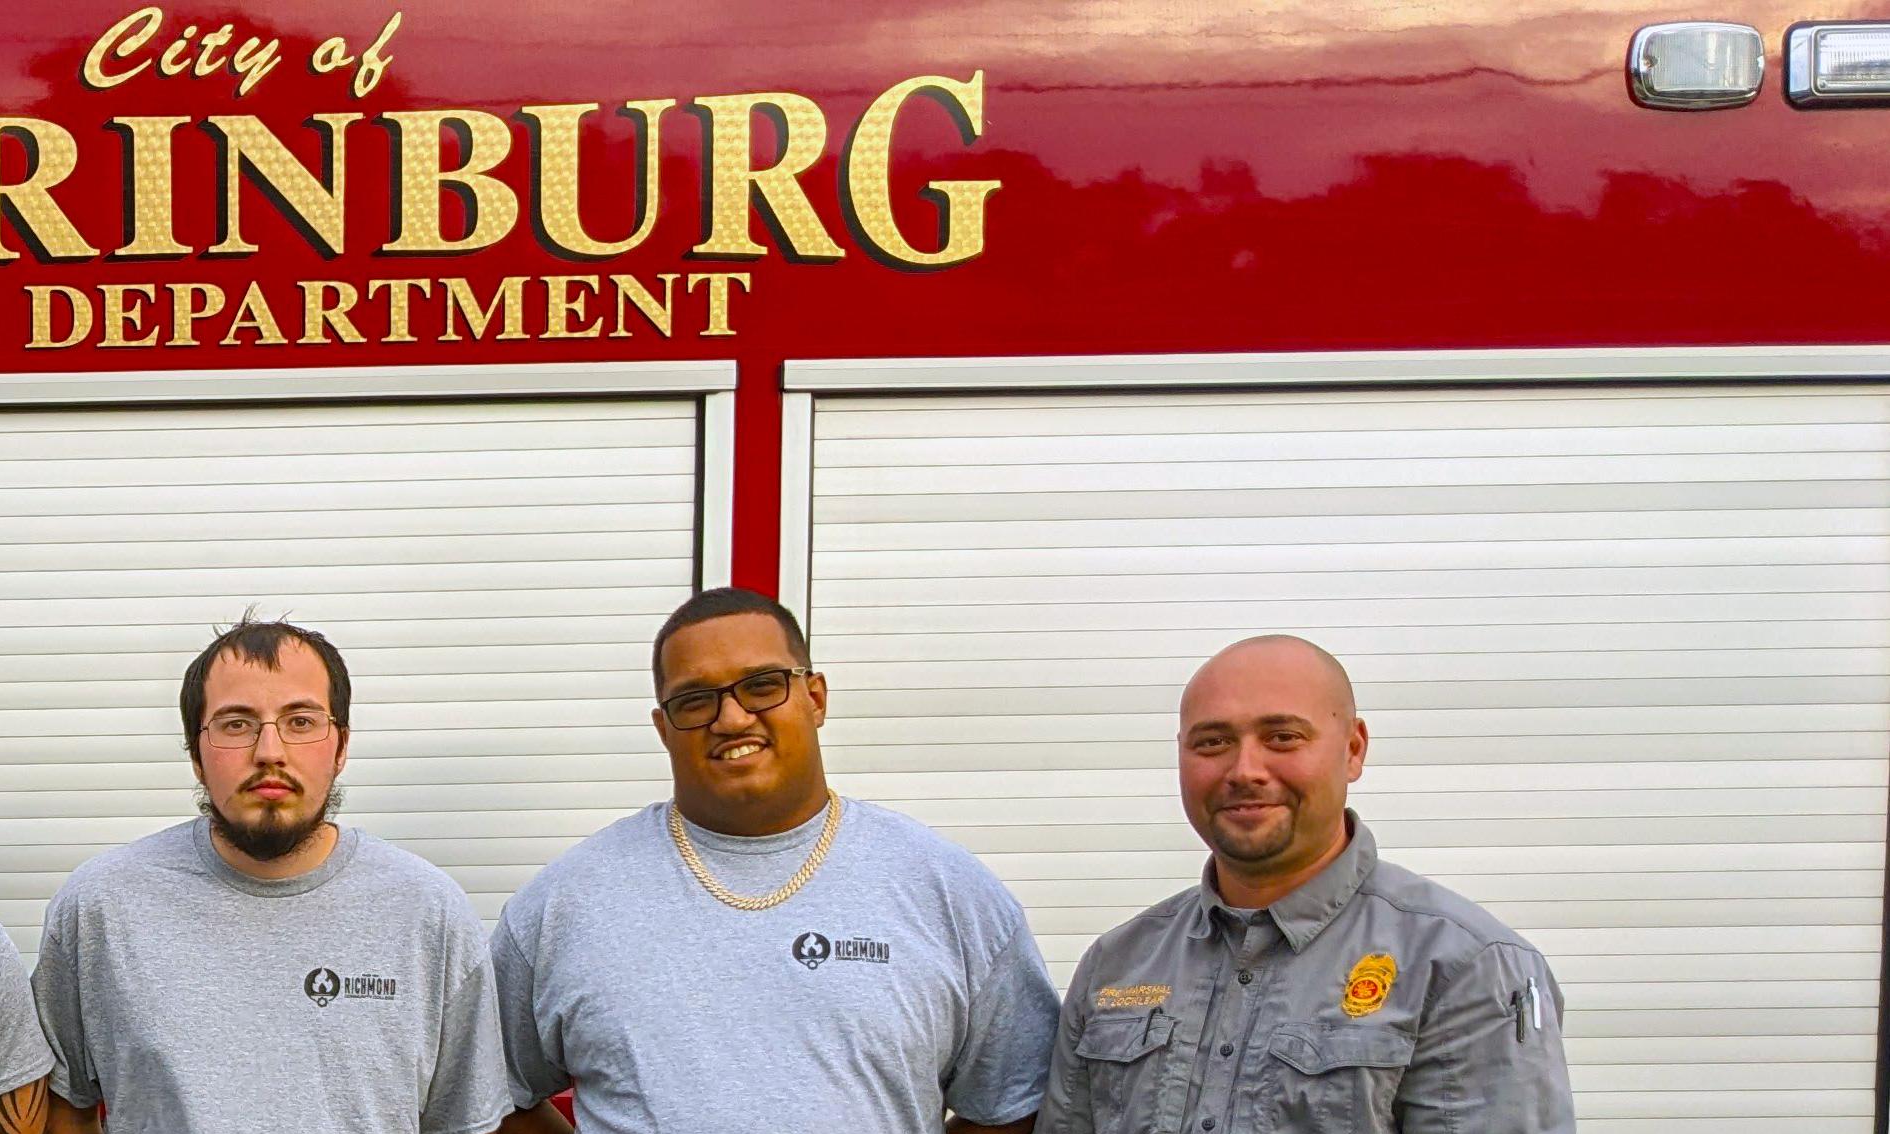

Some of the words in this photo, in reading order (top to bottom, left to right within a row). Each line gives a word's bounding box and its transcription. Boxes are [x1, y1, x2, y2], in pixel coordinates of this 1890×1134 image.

[81, 6, 282, 97] City
[309, 11, 402, 98] of
[24, 272, 751, 350] DEPARTMENT
[835, 940, 890, 959] RICHMOND
[344, 977, 396, 995] RICHMOND
